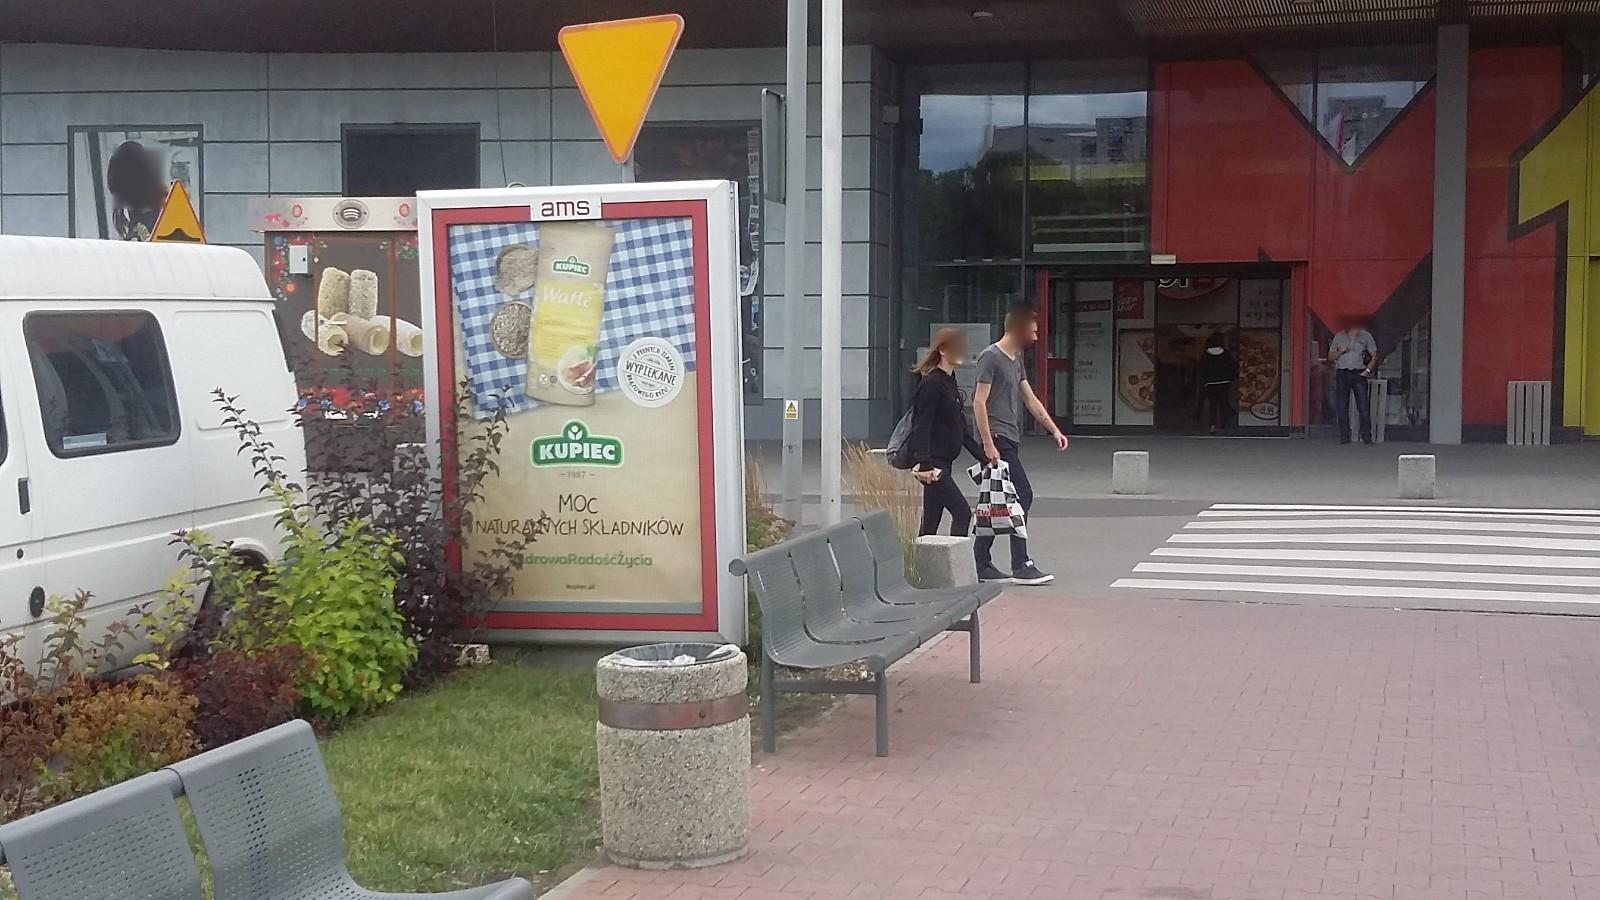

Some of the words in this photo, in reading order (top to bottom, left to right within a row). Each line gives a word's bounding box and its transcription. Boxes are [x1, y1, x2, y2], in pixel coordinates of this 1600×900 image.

[541, 200, 590, 217] ams
[625, 360, 677, 386] WYPIEKANE
[539, 442, 616, 461] KUPIEC
[558, 493, 599, 514] MOC
